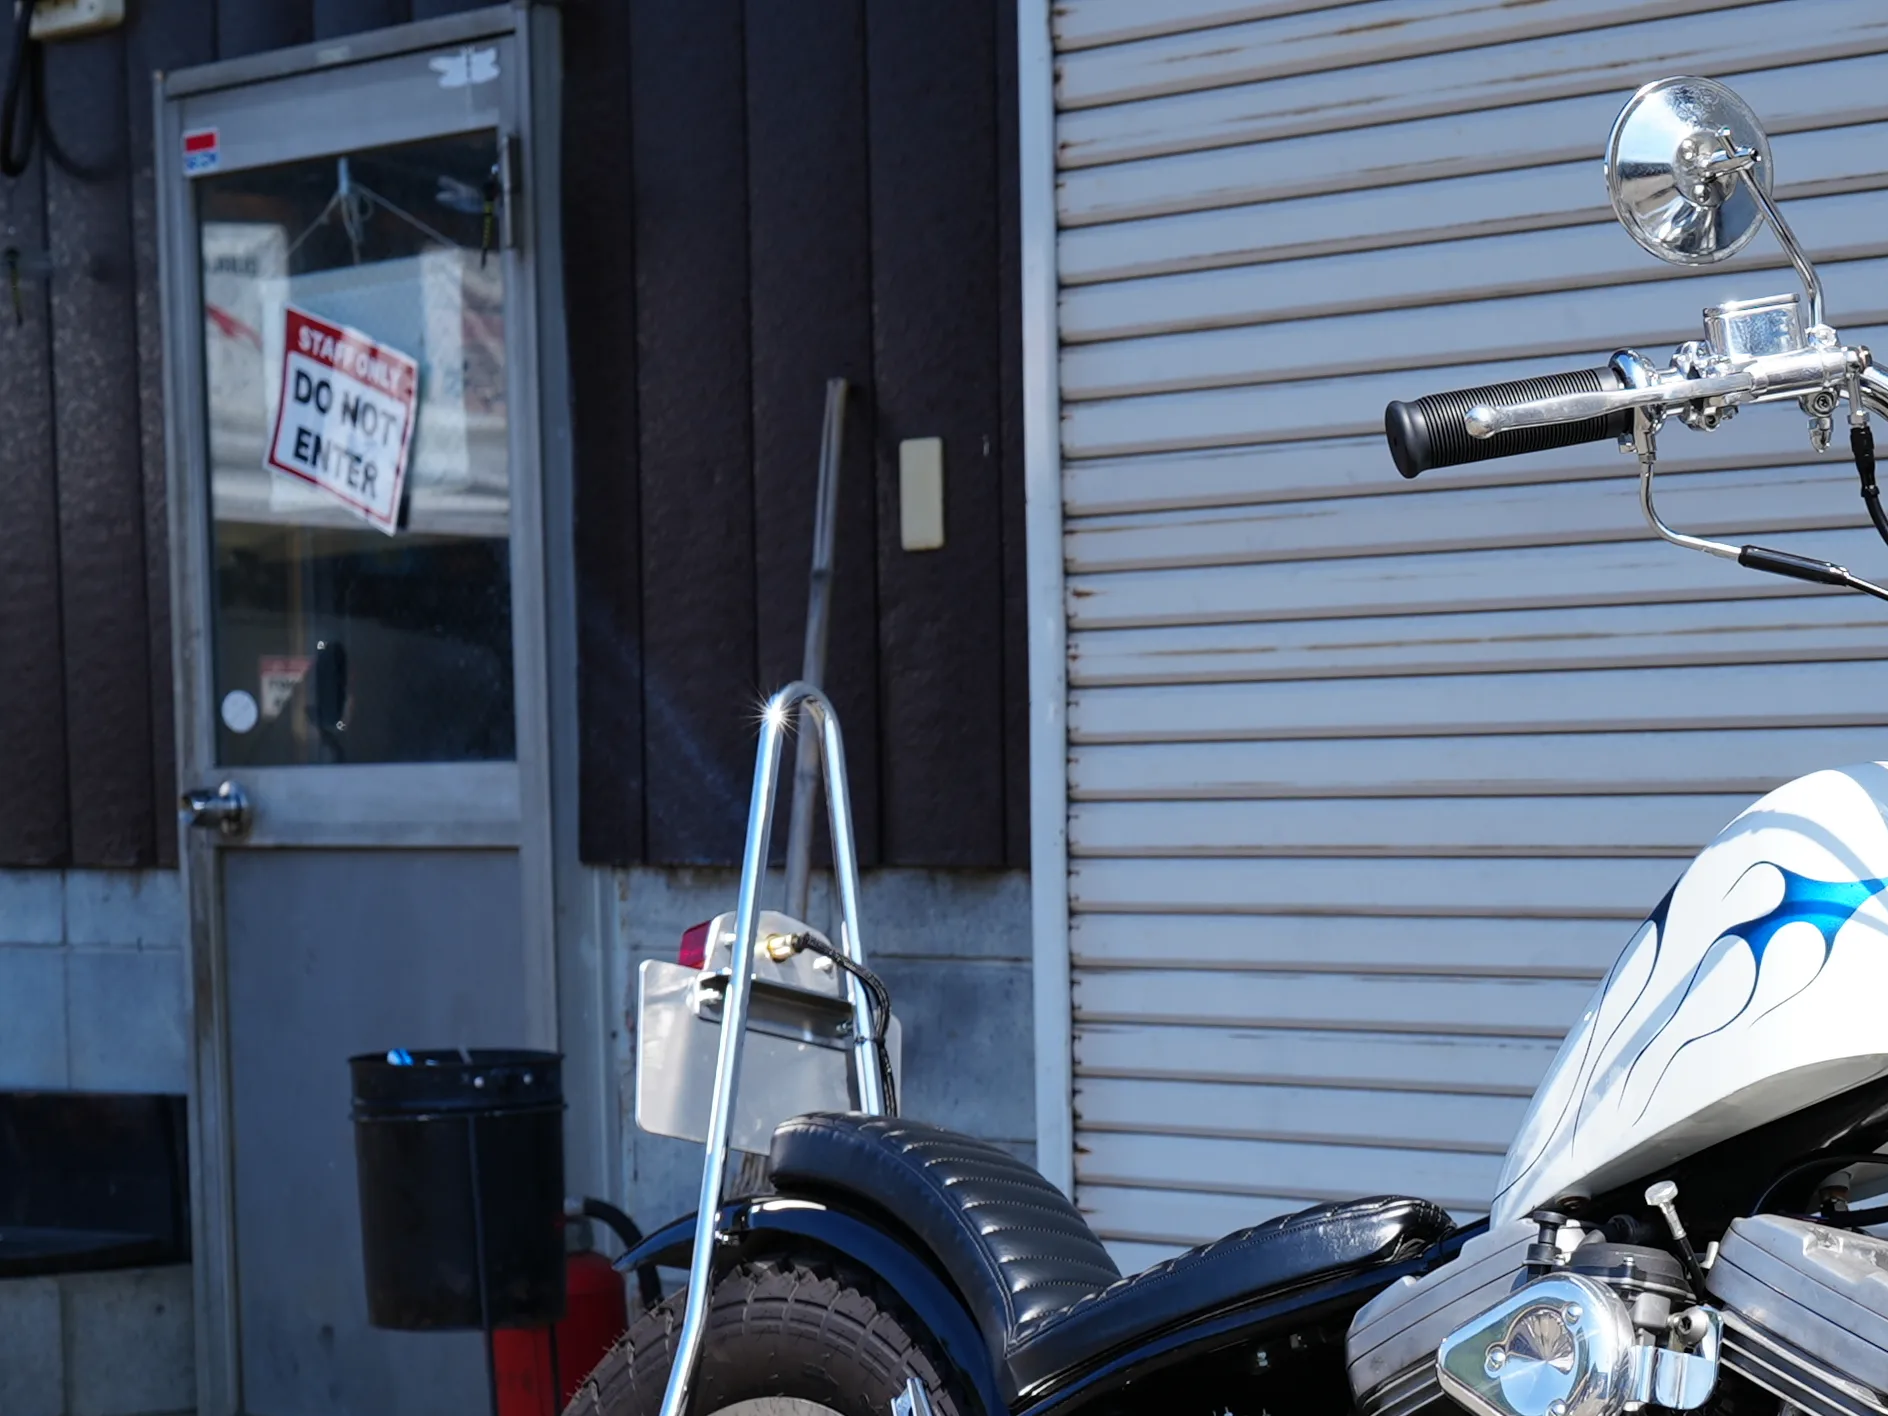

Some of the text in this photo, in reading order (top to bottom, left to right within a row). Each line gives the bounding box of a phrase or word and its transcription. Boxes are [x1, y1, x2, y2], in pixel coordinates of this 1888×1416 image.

[297, 325, 404, 391] STAFF ONLY
[294, 369, 397, 446] DO NOT
[294, 426, 379, 500] ENTER
